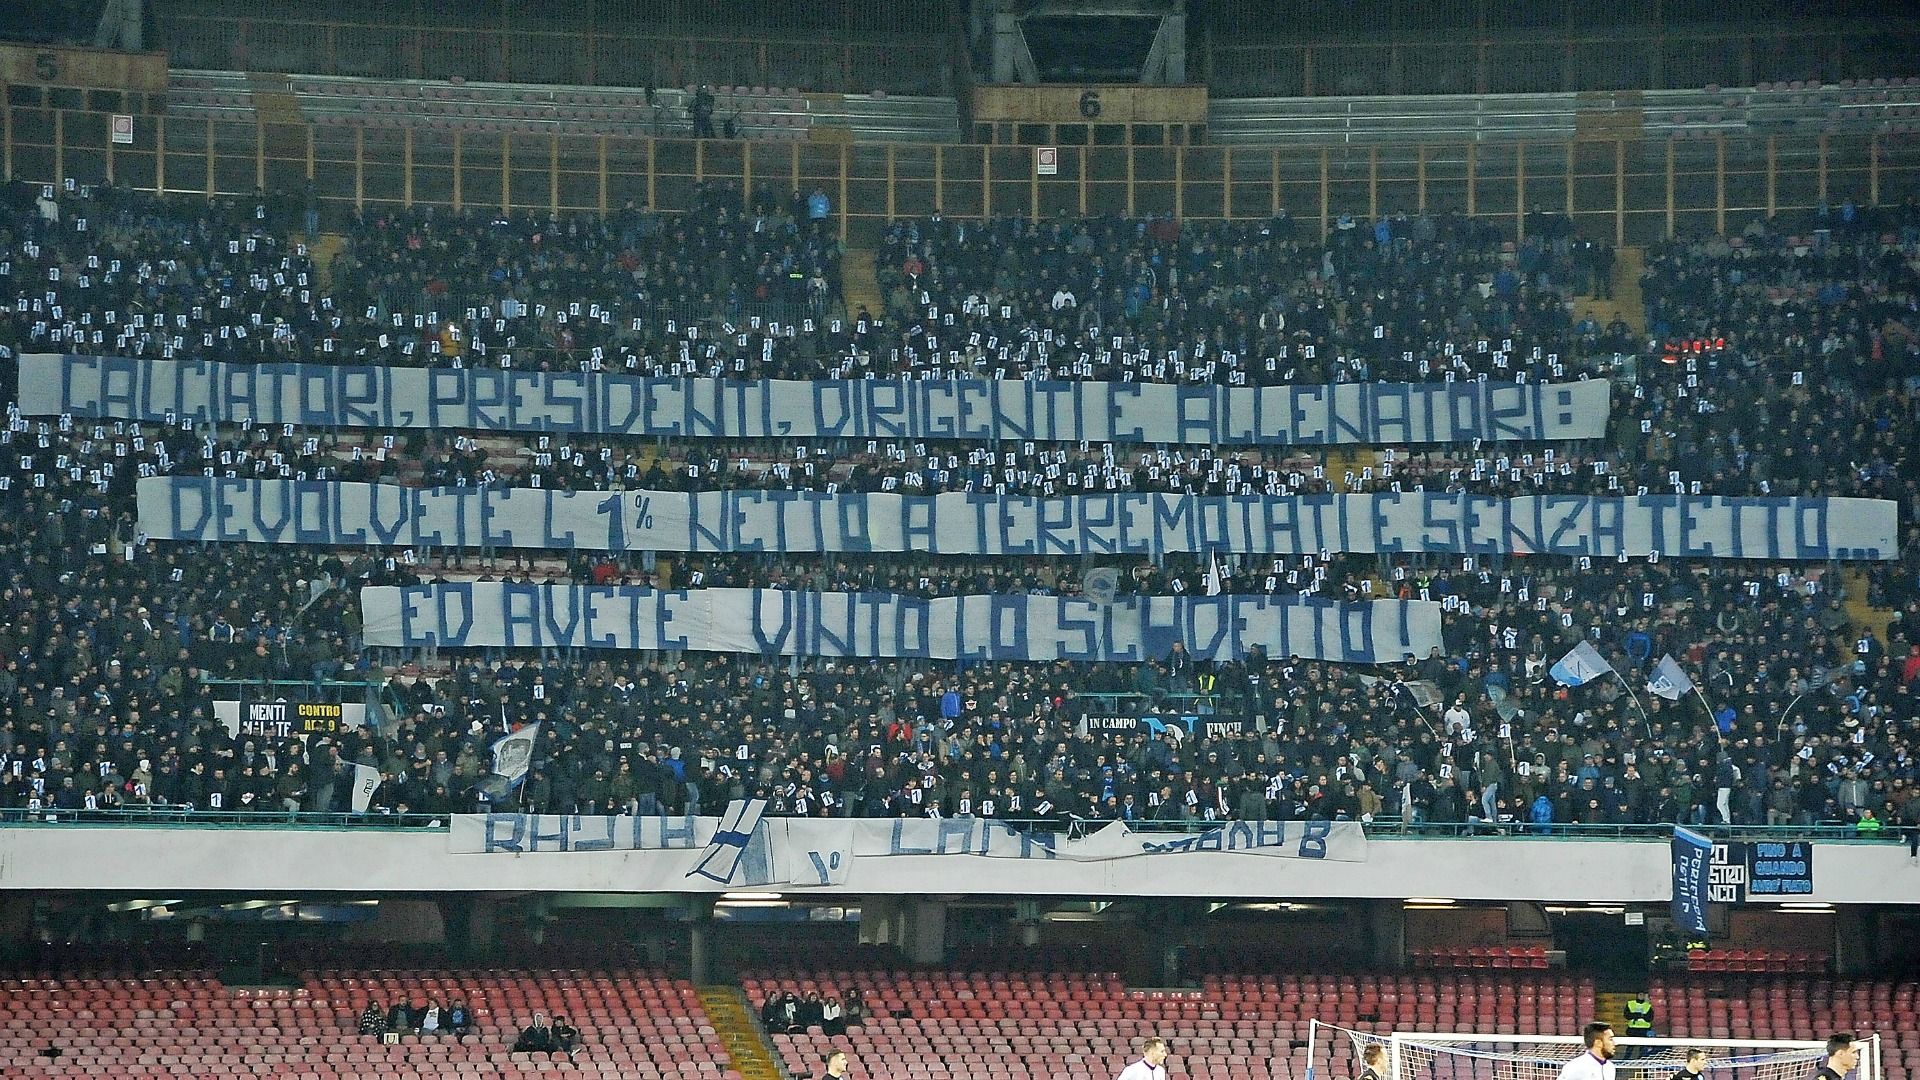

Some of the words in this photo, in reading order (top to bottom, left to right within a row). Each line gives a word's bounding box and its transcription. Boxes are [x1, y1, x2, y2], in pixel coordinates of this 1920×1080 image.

[1079, 91, 1102, 118] 6
[62, 355, 413, 428] CALCIATORI,
[429, 368, 791, 437] PRESIDENTI,
[813, 378, 1083, 441] DIRIGENTI
[1108, 382, 1143, 441] E
[1178, 383, 1572, 444] ALLENATORI:
[171, 476, 512, 548] DEVOLVETE
[690, 491, 871, 553] NETTO
[903, 494, 936, 553] A
[966, 493, 1347, 556] TERREMOTATI
[1372, 493, 1401, 554] E
[1422, 494, 1623, 556] SENZA
[401, 584, 473, 647] ED
[502, 585, 688, 650] AVETE
[753, 588, 930, 657] VINTO
[956, 594, 1030, 660] LO
[250, 704, 286, 721] MENTI
[299, 704, 341, 717] CONTRO
[1090, 718, 1100, 729] IN
[1103, 718, 1137, 729] CAMPO
[1757, 843, 1786, 857] FINO
[1792, 843, 1802, 857] A
[1755, 861, 1806, 875] QUANDO
[1781, 879, 1811, 893] FIATO
